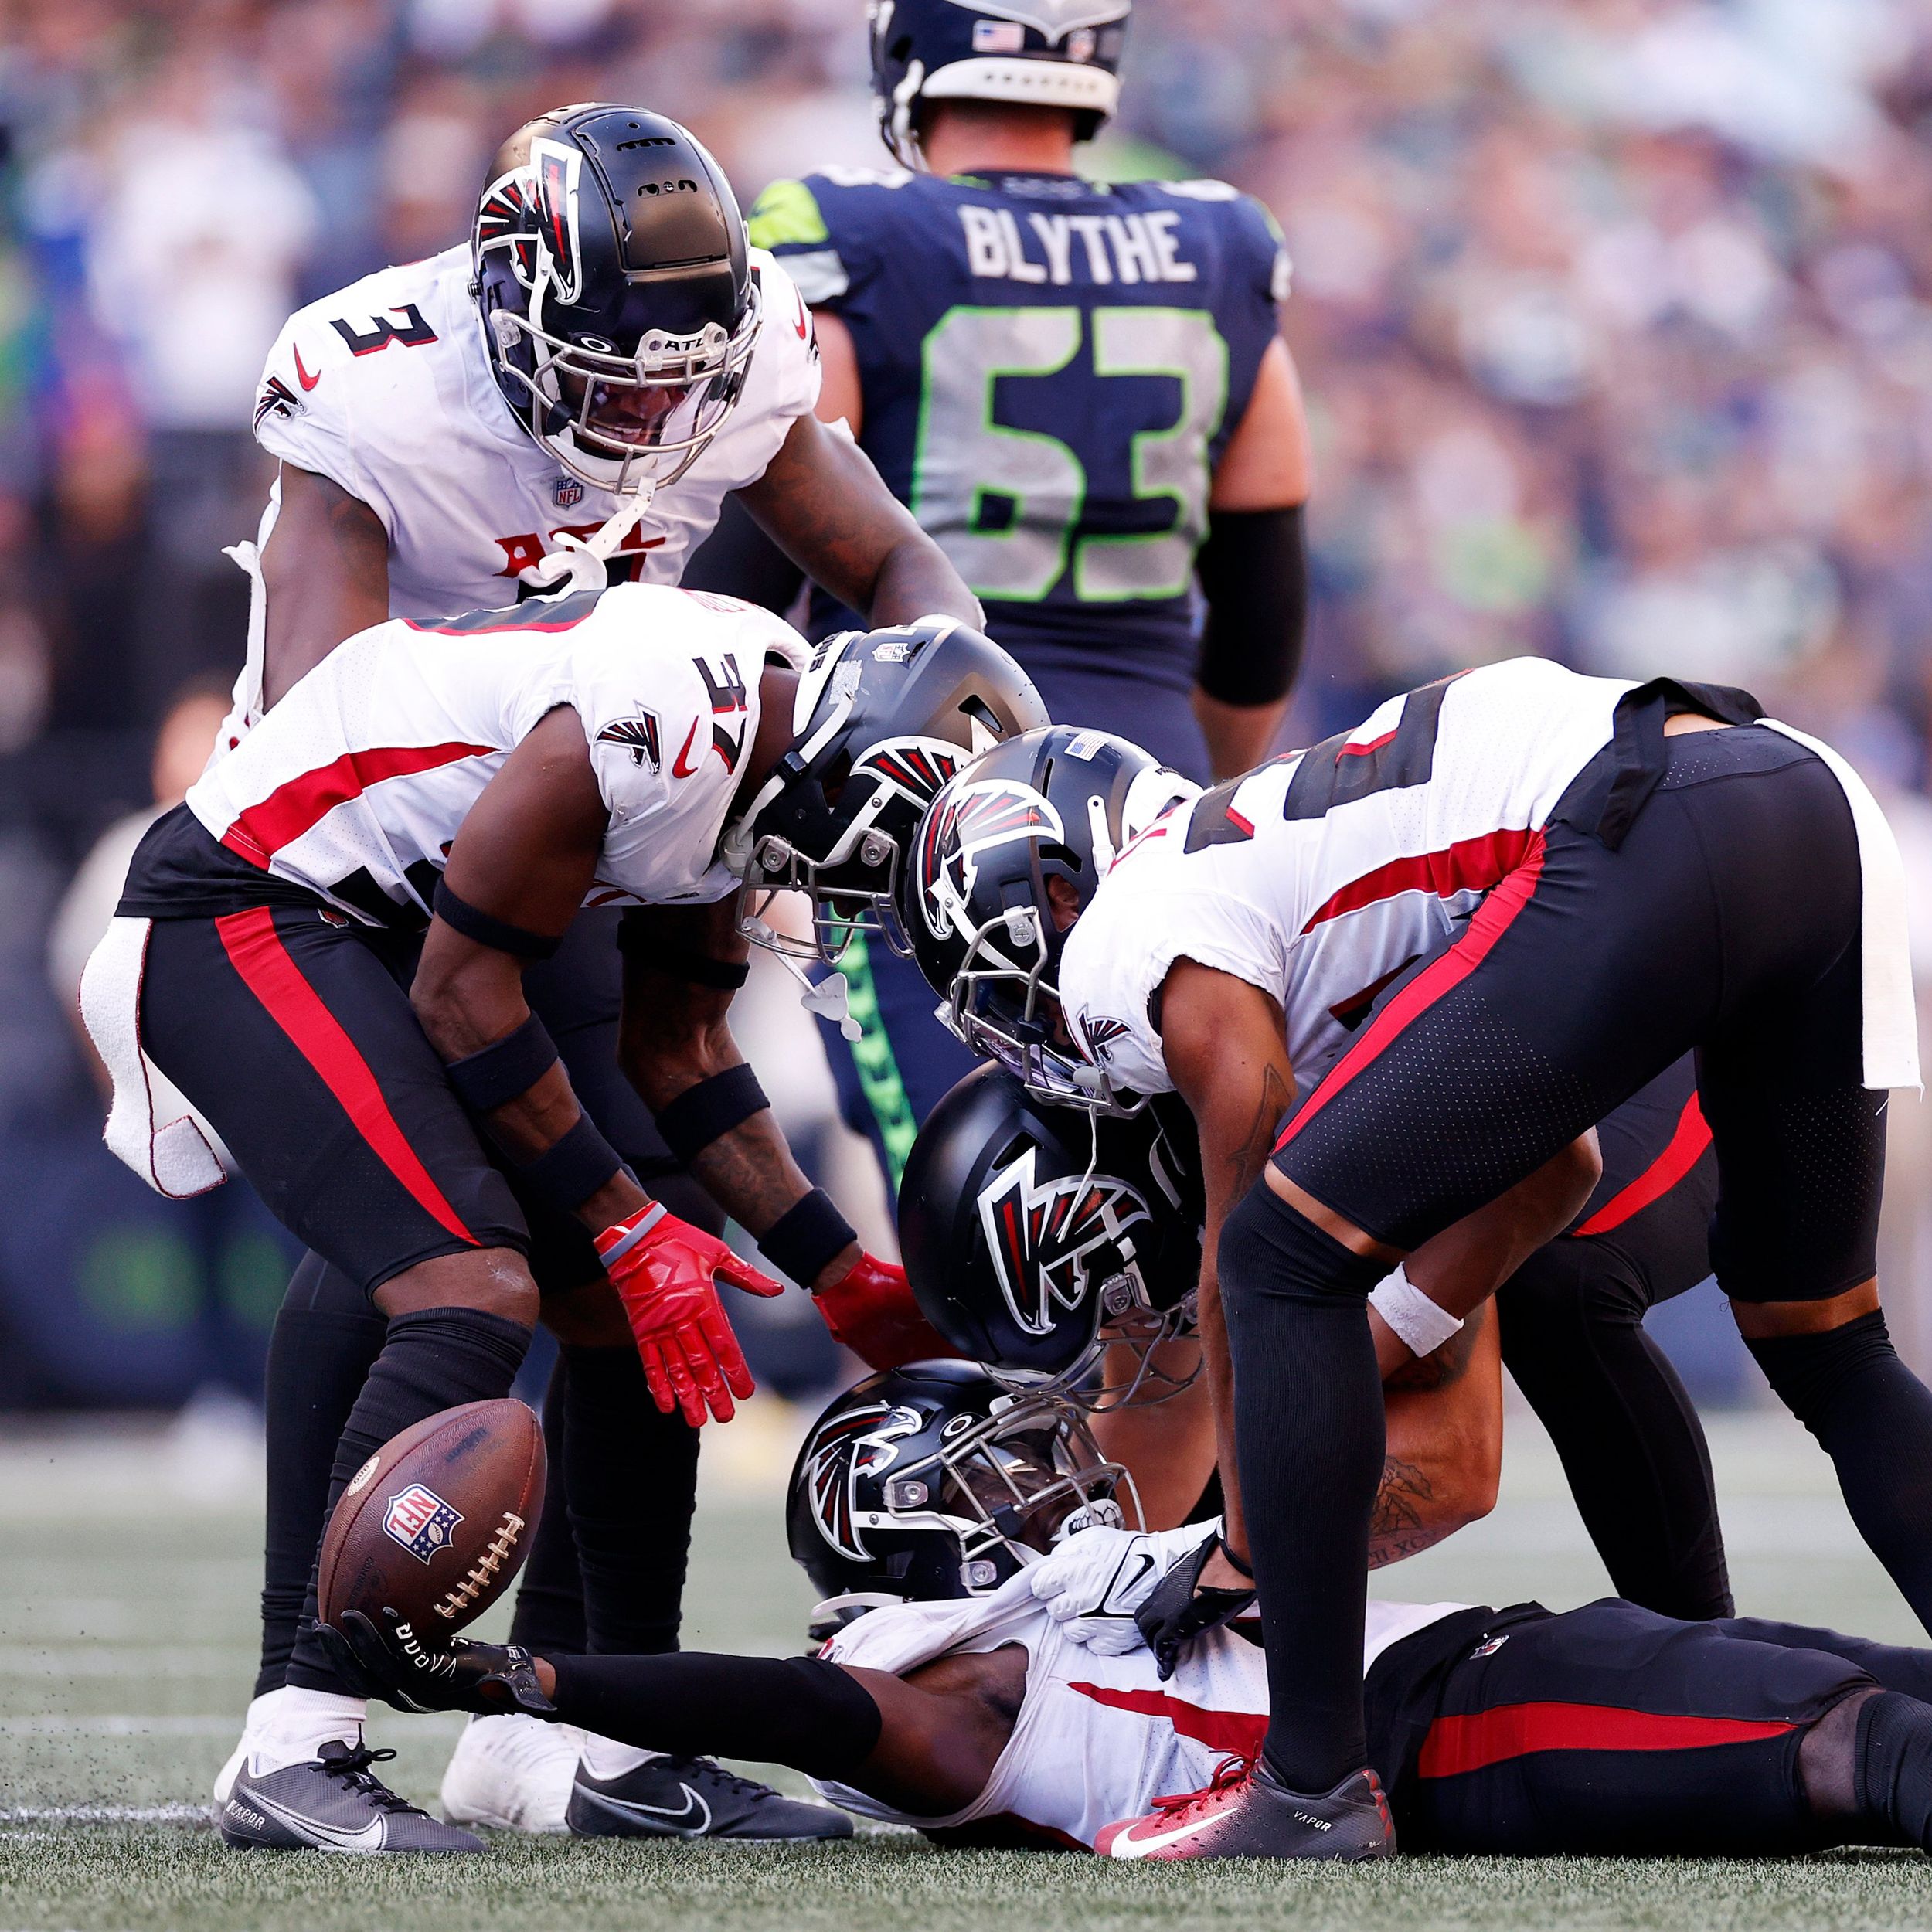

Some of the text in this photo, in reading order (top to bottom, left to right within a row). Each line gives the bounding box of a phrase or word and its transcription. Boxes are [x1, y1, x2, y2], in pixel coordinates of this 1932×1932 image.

[957, 204, 1198, 284] BLYTHE
[328, 303, 439, 357] 3
[910, 304, 1230, 602] 63
[559, 488, 580, 504] NFL
[389, 1490, 437, 1539] NFL
[1294, 1810, 1332, 1832] VAPOR
